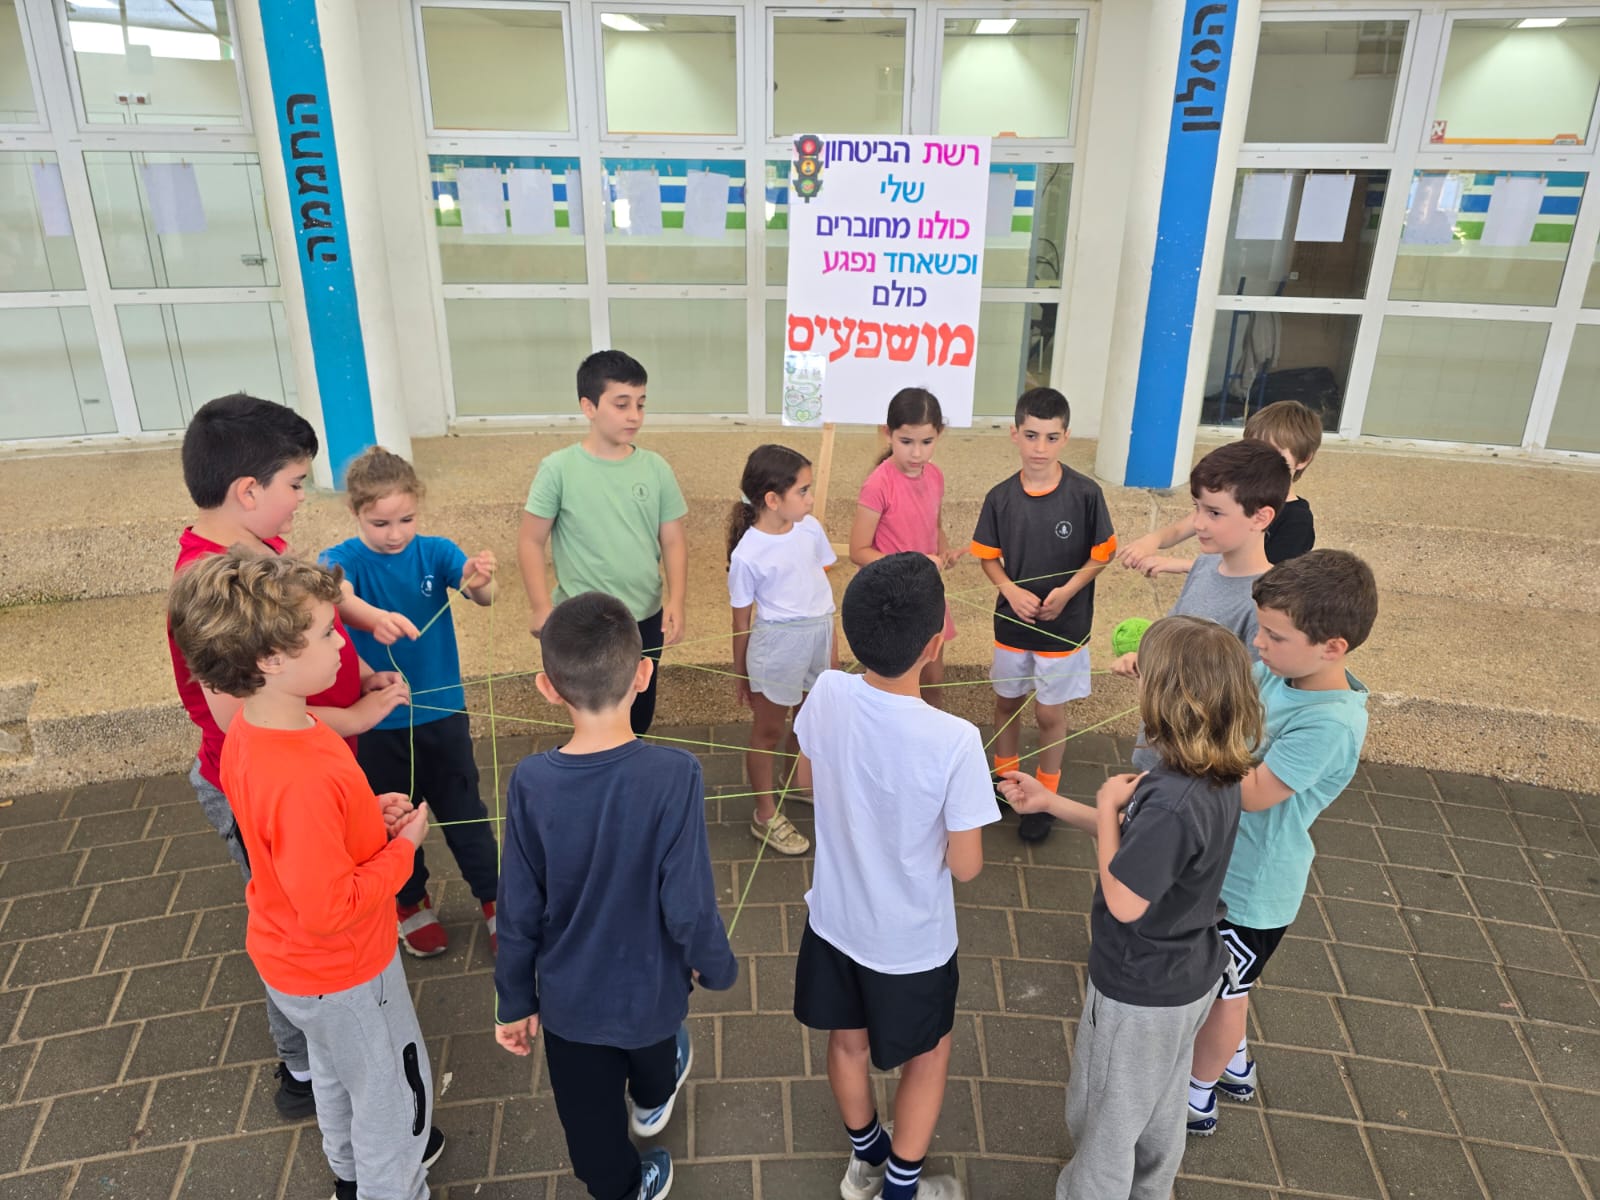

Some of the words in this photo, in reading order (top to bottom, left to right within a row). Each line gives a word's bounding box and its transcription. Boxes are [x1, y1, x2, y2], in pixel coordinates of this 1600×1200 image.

[1175, 3, 1228, 132] הסלון
[824, 141, 911, 169] הביטחון
[922, 142, 980, 167] רשת
[286, 93, 338, 263] החממה
[880, 173, 926, 204] שלי
[816, 215, 911, 239] מחוברים
[917, 210, 971, 240] כולנו
[822, 250, 876, 274] נפגע
[883, 251, 978, 275] וכשאחד
[872, 279, 927, 307] כולם
[787, 313, 975, 367] מושפעים
